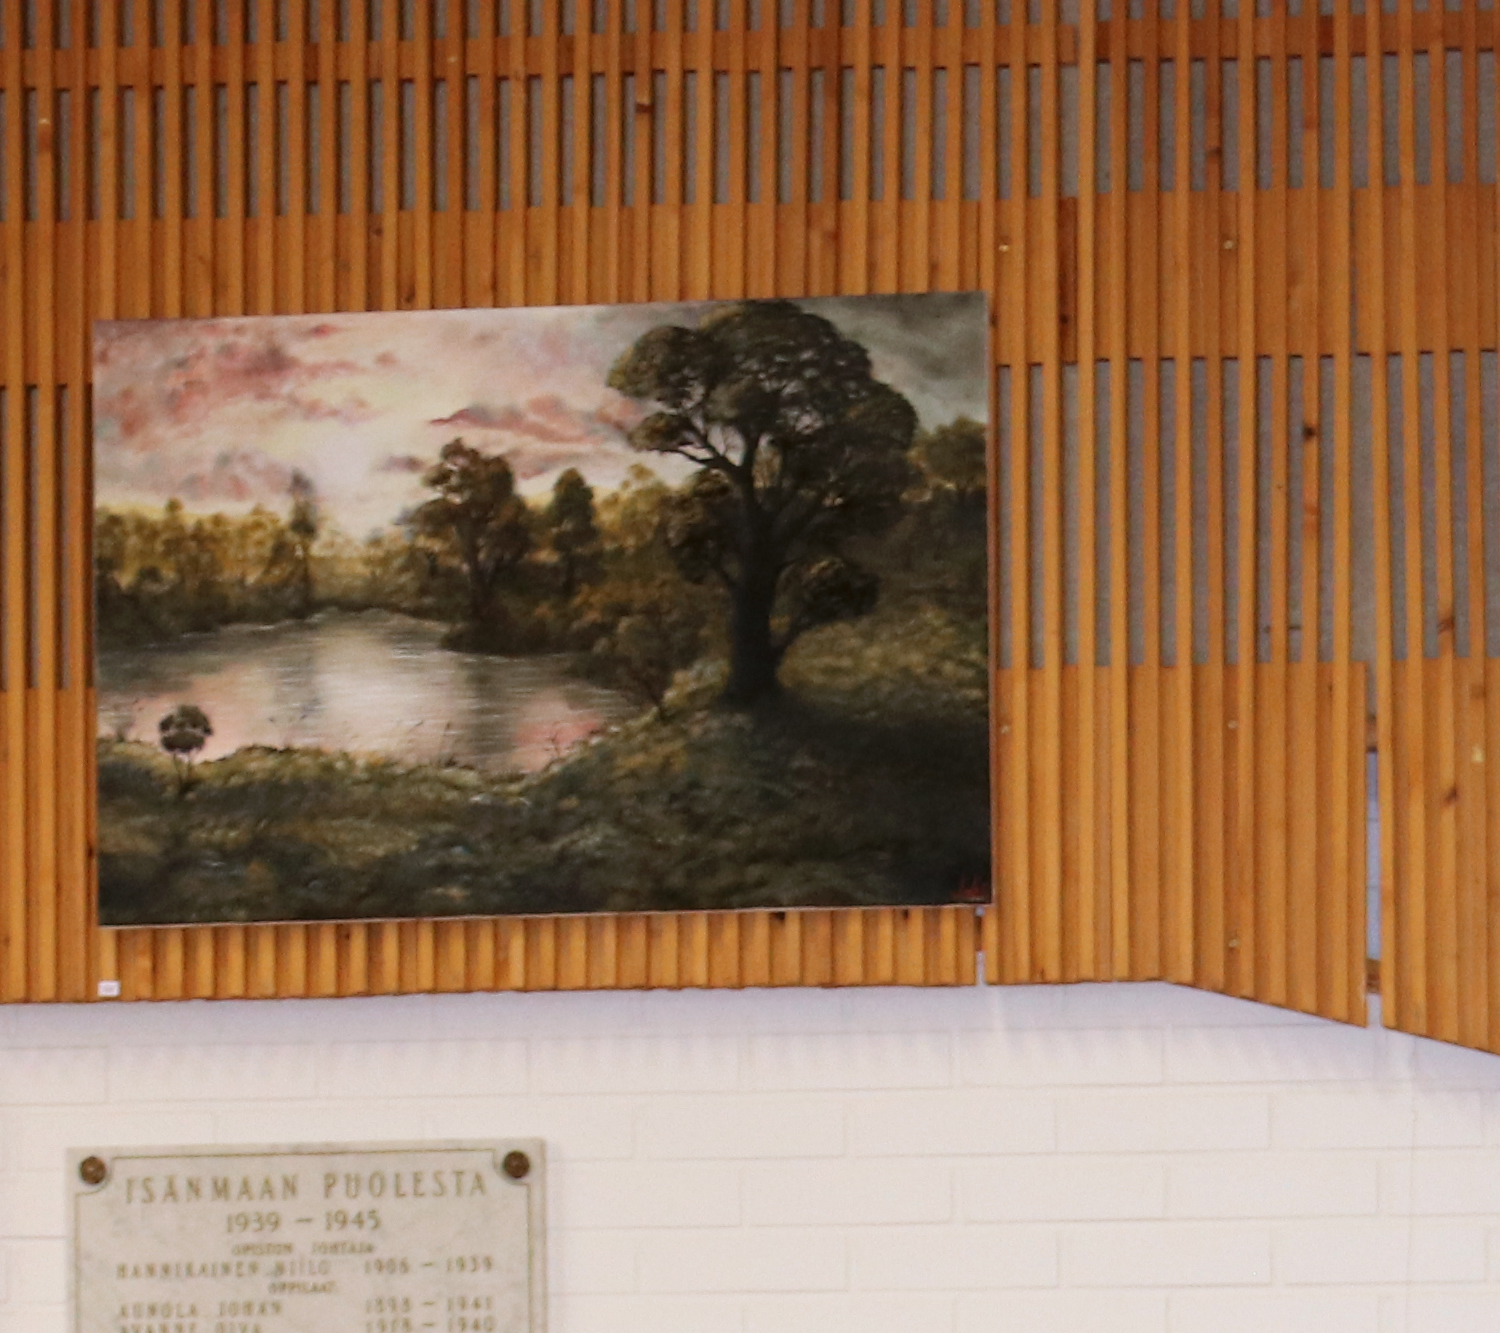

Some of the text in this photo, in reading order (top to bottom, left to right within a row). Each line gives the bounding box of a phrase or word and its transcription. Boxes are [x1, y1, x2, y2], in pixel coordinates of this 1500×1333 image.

[125, 1169, 488, 1205] ISÄNMAAN PUOLESTA
[226, 1210, 281, 1234] 1939
[324, 1209, 382, 1233] 1945
